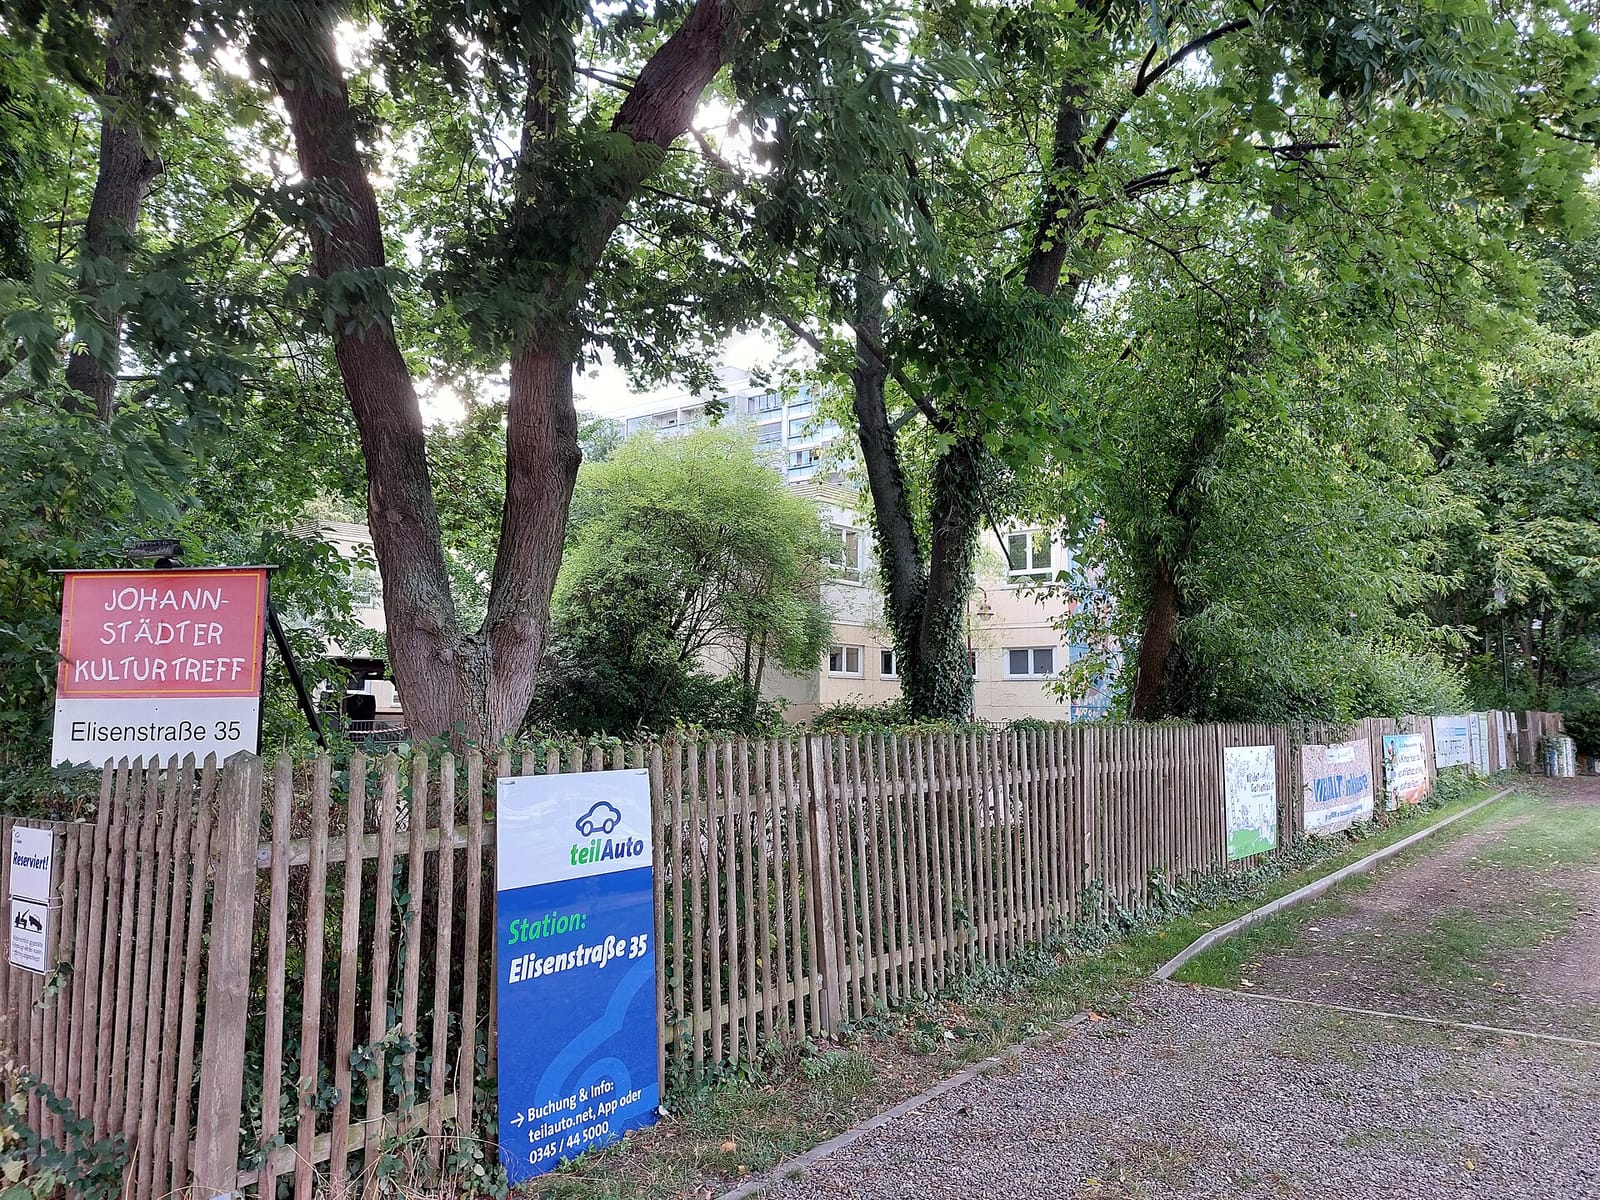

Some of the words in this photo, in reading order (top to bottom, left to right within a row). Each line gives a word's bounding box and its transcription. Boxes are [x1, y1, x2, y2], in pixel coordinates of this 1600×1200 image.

[104, 587, 229, 612] JOHANN-
[100, 618, 224, 646] STÄDTER
[71, 721, 206, 741] Elisenstraße
[213, 721, 241, 741] 35
[13, 851, 49, 871] Reserviert!
[570, 836, 644, 866] teilAuto
[508, 911, 587, 945] Station:
[508, 935, 627, 985] Elisenstraße
[628, 933, 648, 960] 35
[527, 1094, 577, 1122] Buchung
[579, 1087, 588, 1102] &
[590, 1079, 614, 1099] Info:
[528, 1106, 597, 1143] teilauto.net,
[597, 1100, 618, 1117] App
[619, 1089, 642, 1107] oder
[529, 1142, 557, 1165] 0345
[559, 1138, 565, 1153] /
[566, 1132, 580, 1149] 44
[582, 1121, 609, 1143] 5000
